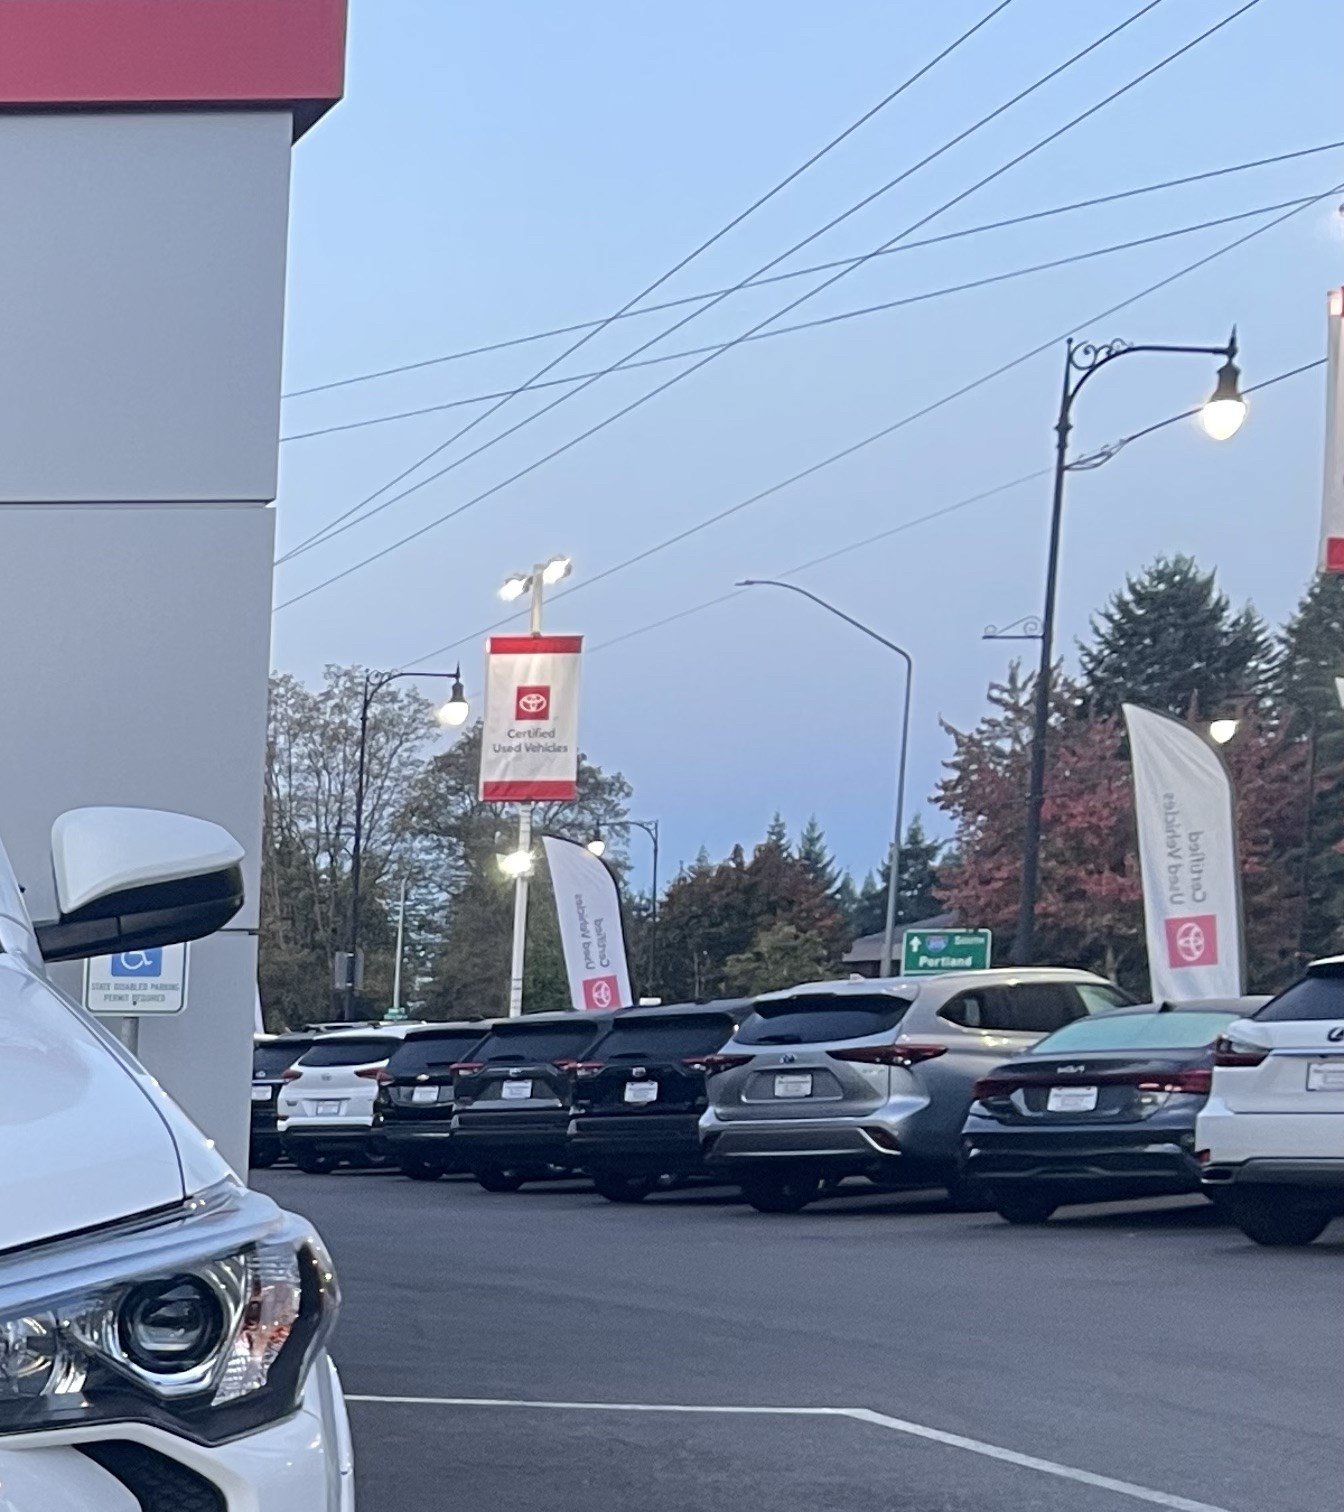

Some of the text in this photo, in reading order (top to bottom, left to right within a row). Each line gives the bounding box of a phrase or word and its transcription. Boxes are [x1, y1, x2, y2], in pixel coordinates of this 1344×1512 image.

[507, 727, 556, 739] Certified
[493, 742, 568, 753] Used Vehicles
[918, 955, 972, 968] Portland
[91, 982, 111, 991] STATE
[150, 983, 180, 992] PARKING
[103, 994, 129, 1002] PERMIT
